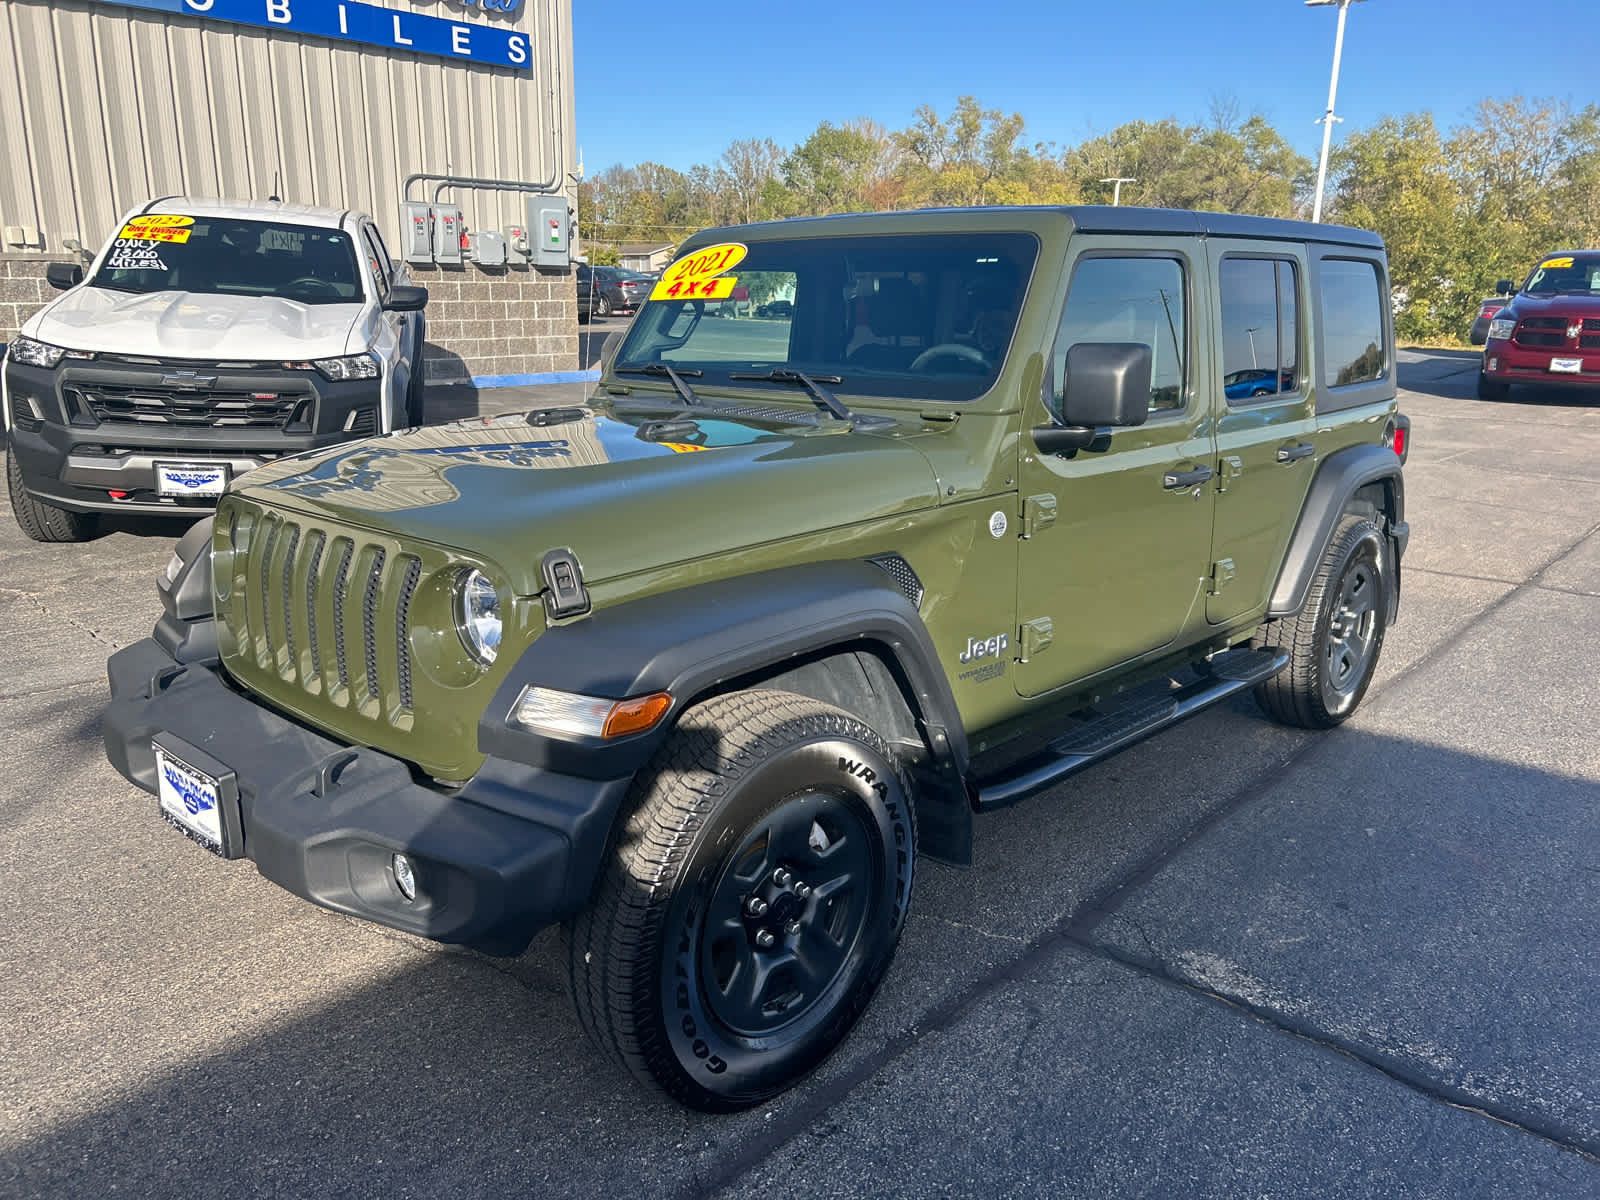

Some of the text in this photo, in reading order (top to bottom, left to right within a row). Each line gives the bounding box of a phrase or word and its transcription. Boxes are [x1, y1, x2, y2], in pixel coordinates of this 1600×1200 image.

[150, 226, 186, 235] OWNER
[114, 238, 161, 251] ONLY
[673, 247, 735, 281] 2021
[959, 632, 1008, 665] Jeep
